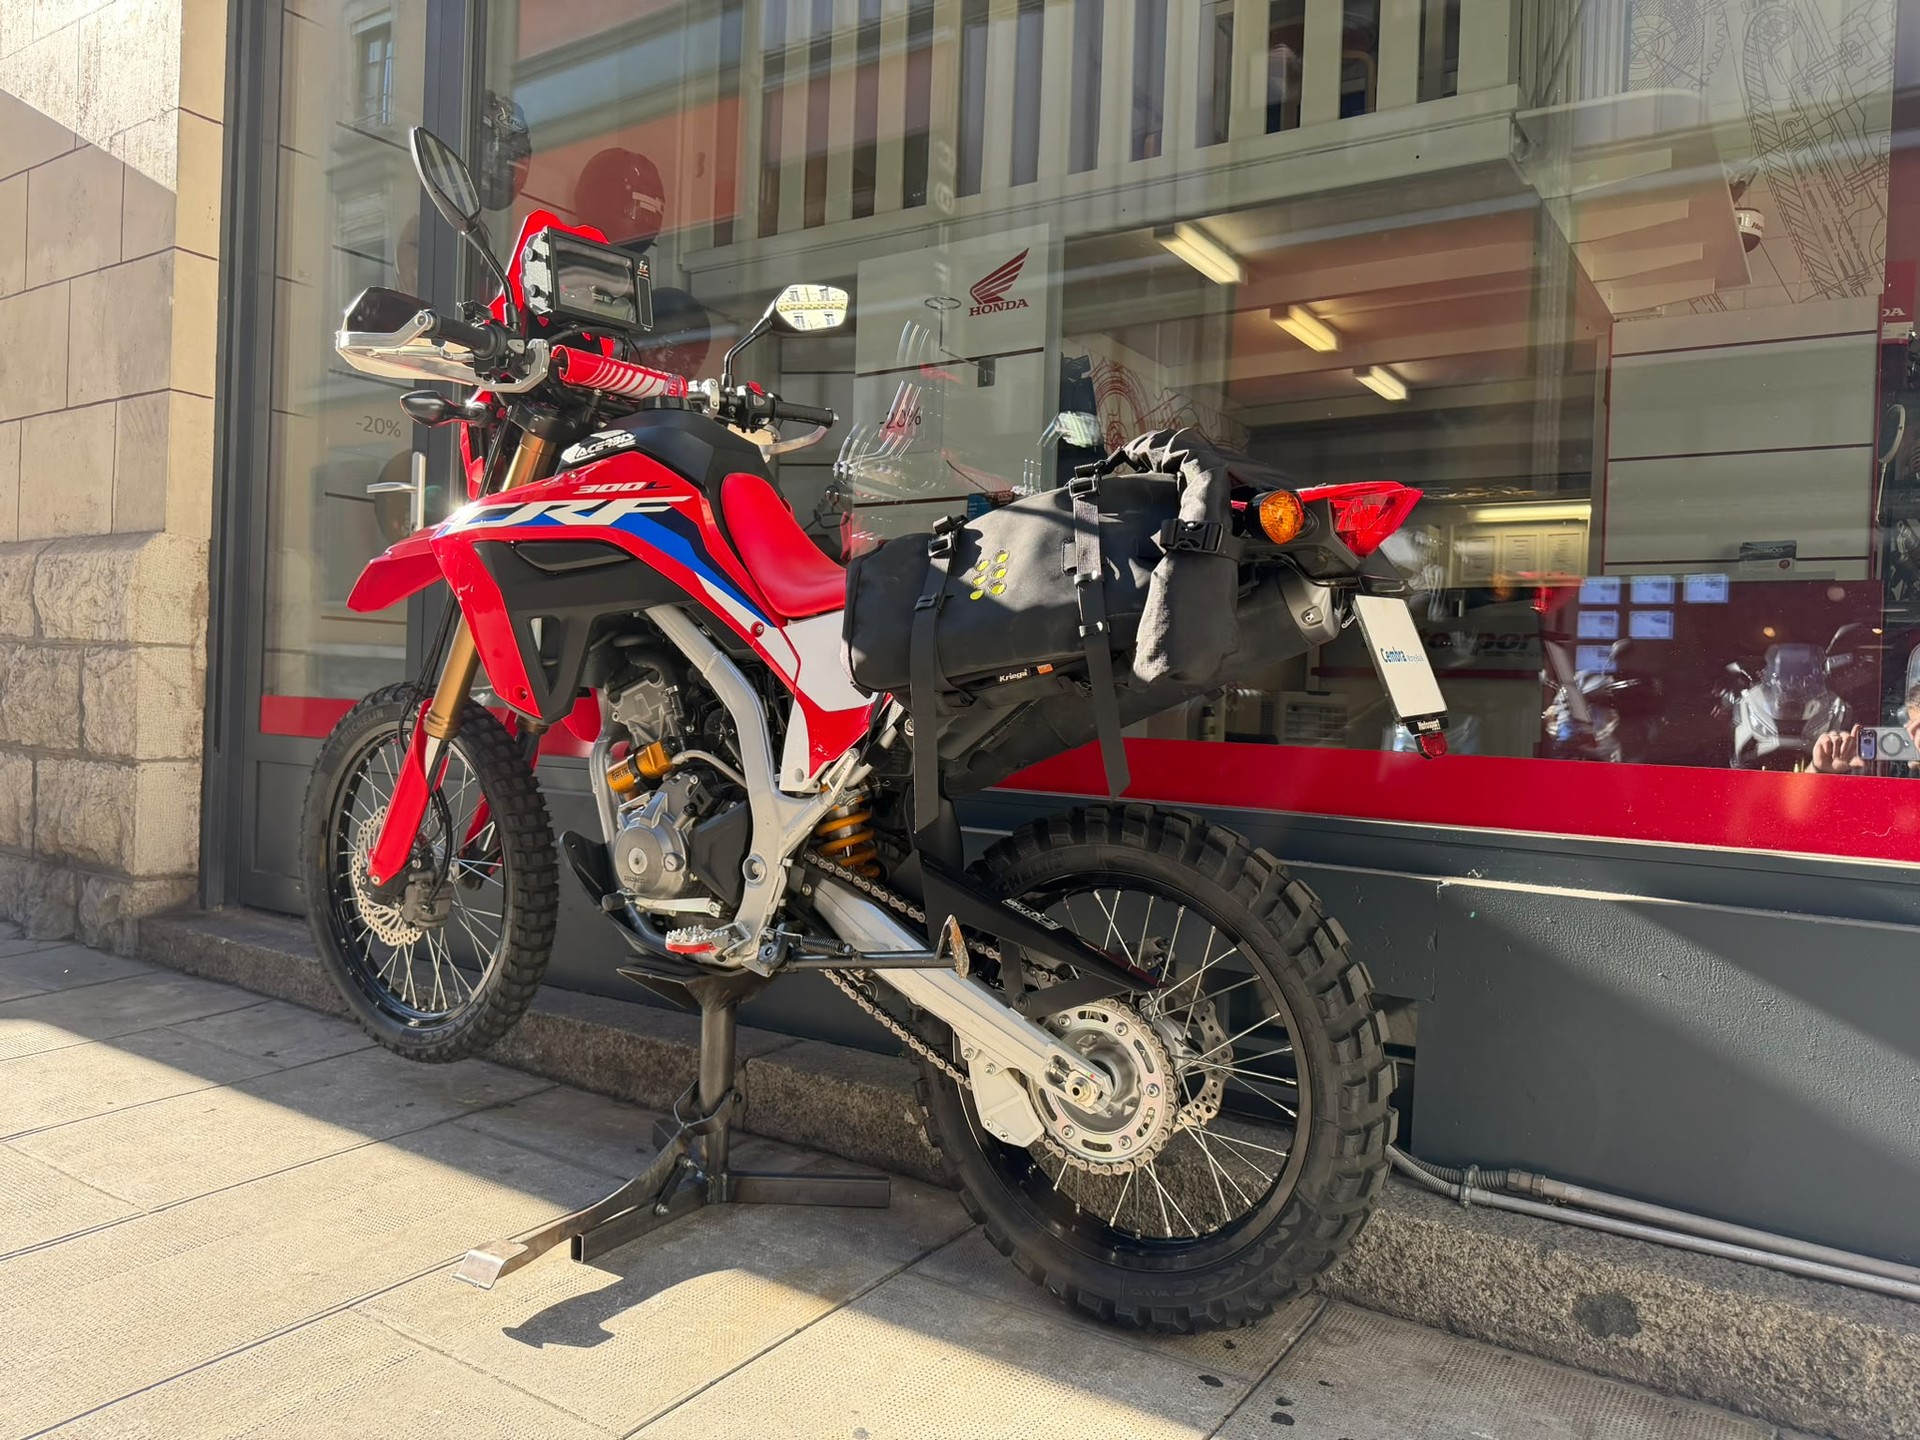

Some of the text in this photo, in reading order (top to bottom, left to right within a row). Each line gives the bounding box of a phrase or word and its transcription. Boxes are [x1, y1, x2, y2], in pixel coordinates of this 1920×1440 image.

[969, 299, 1029, 317] HONDA
[355, 415, 401, 437] -20%
[879, 407, 921, 429] -20%
[572, 481, 672, 494] 300L
[438, 496, 693, 536] CRF
[1380, 647, 1407, 663] Cembra
